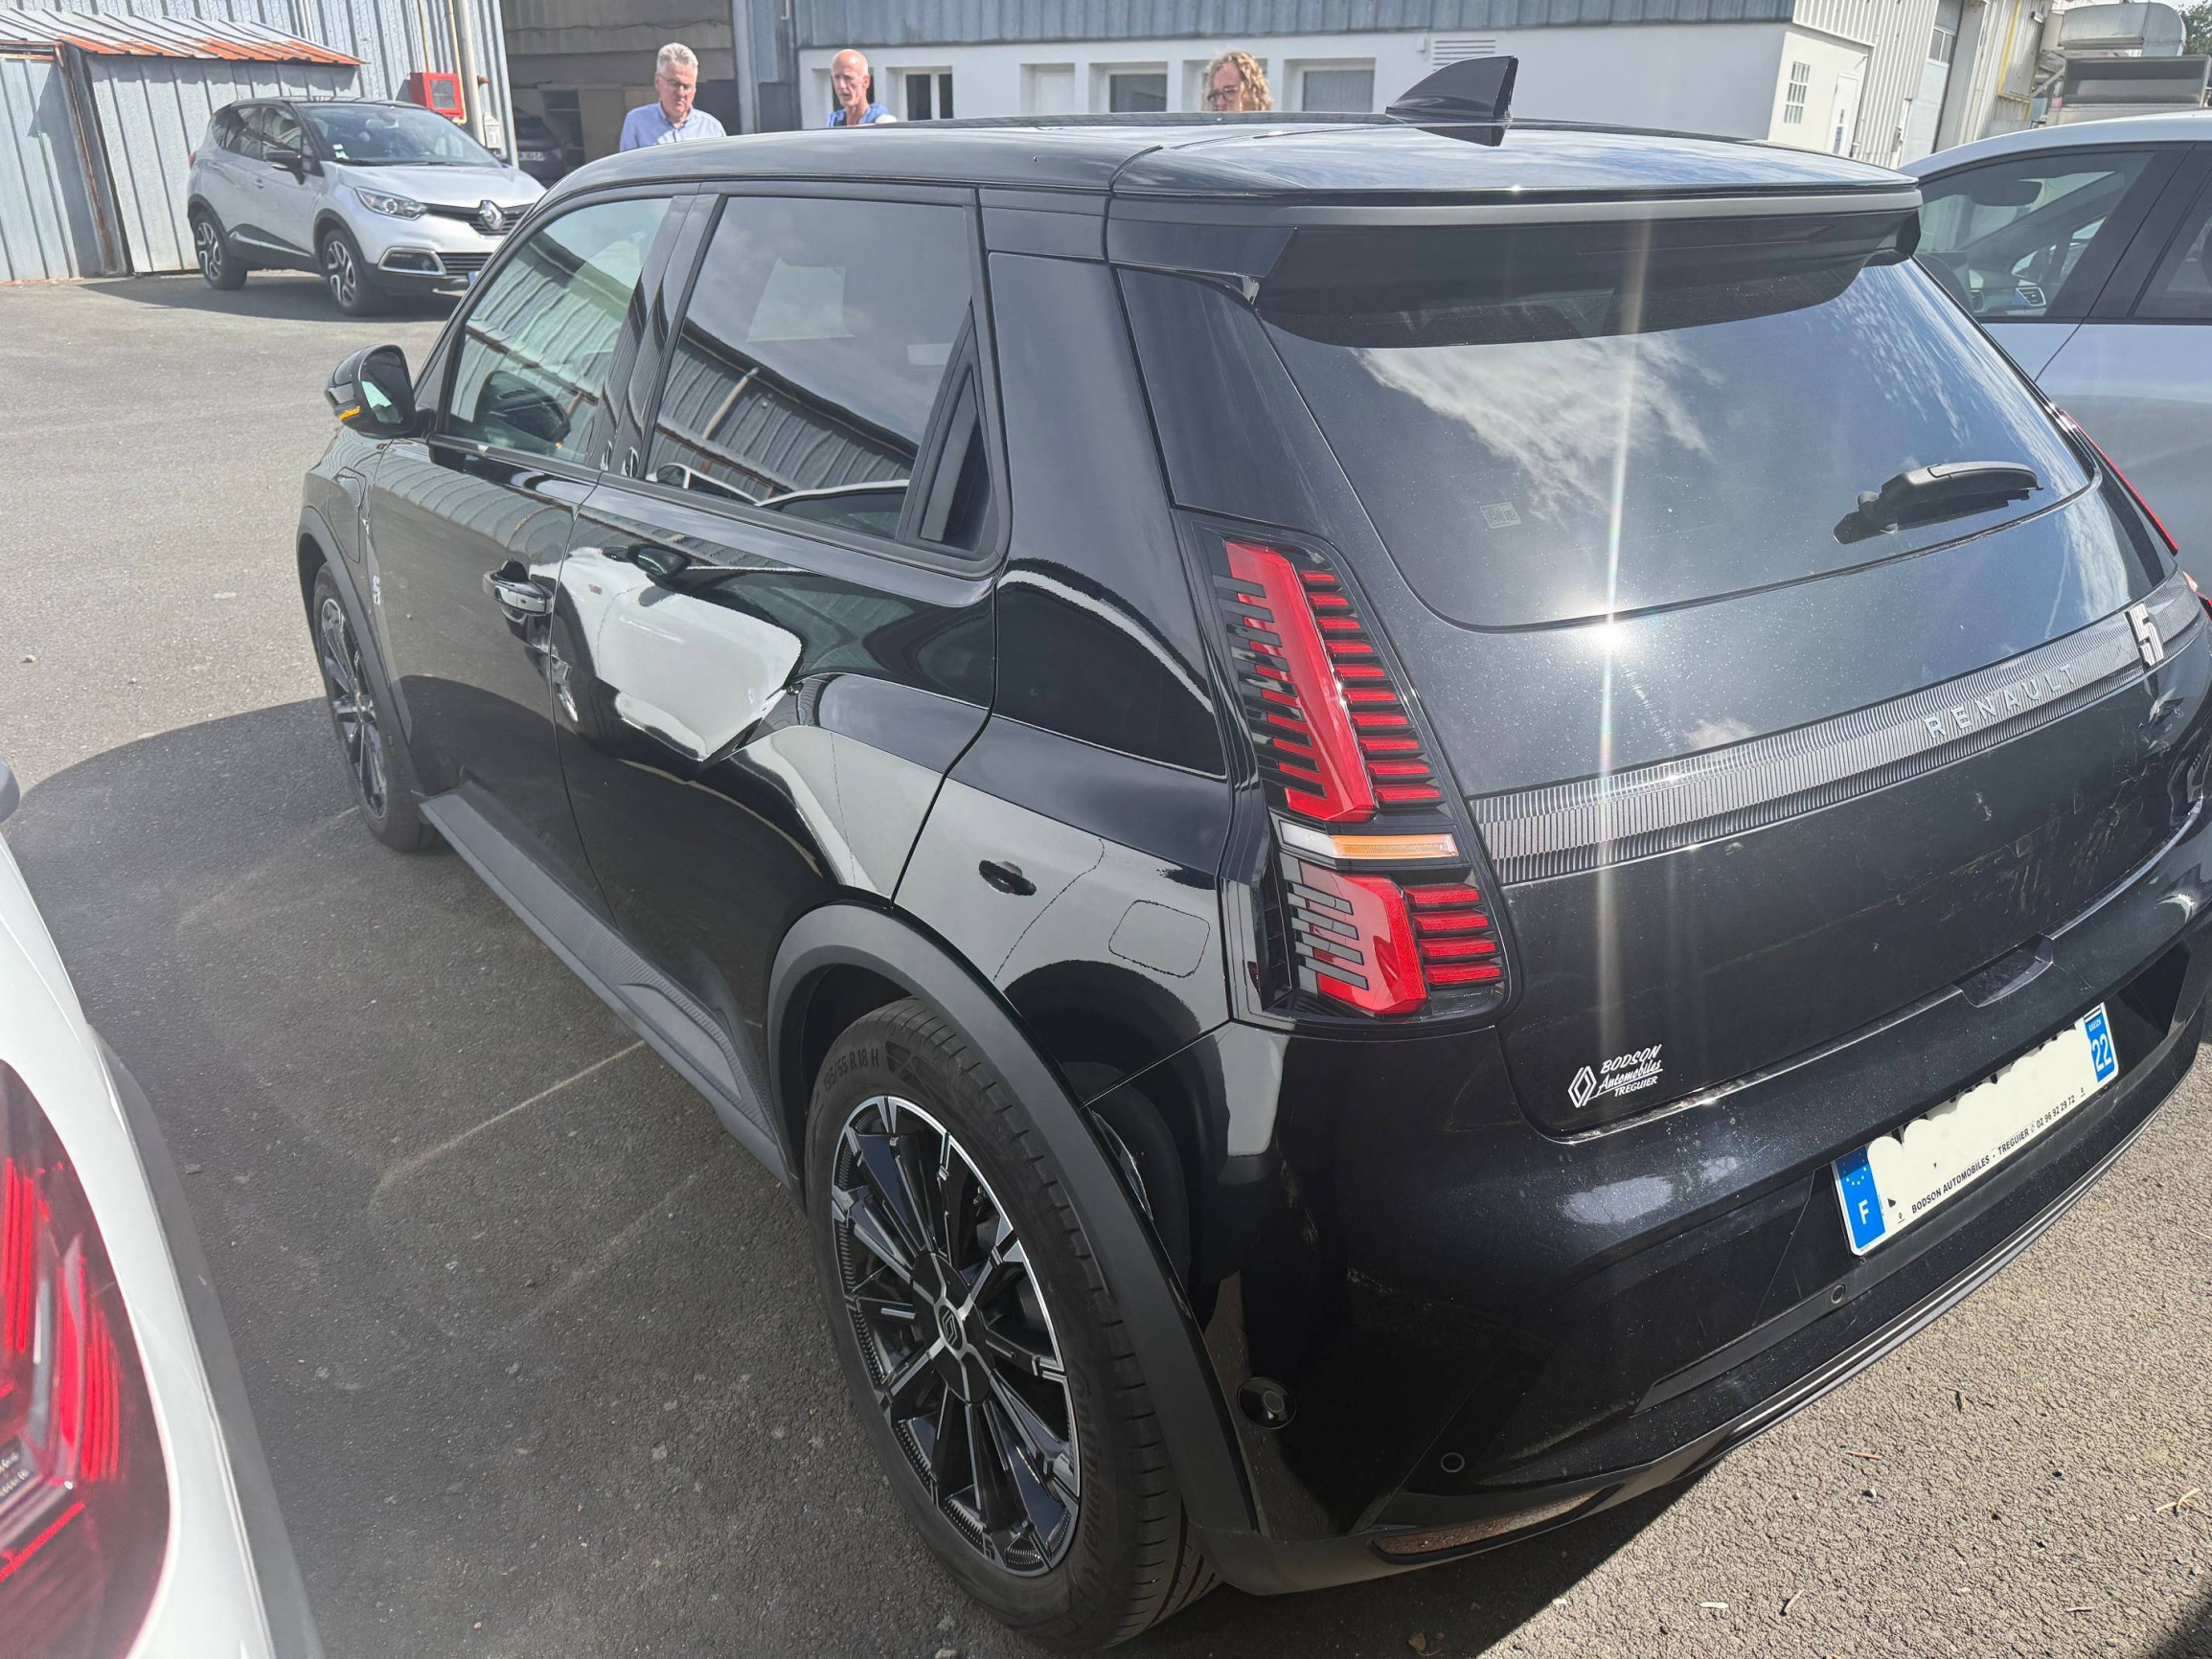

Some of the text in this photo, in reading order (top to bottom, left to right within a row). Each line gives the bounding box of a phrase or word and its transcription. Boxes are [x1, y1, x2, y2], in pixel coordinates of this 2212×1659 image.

[2122, 602, 2164, 670] 5
[1923, 663, 2077, 740] RENAULT
[824, 1048, 879, 1092] 195/55 R 18 H
[1600, 1043, 1663, 1074] BODSON
[2091, 1034, 2112, 1072] 22
[1599, 1059, 1662, 1091] Automobiles
[1614, 1076, 1658, 1097] TREGUIER
[1911, 1188, 1942, 1214] BODSON
[1943, 1154, 1990, 1193] AUTOMOBILES
[1997, 1128, 2030, 1155] TREGUIER
[2036, 1118, 2044, 1128] 02
[2044, 1111, 2052, 1124] 96
[2052, 1105, 2061, 1117] 92
[2060, 1101, 2068, 1111] 29
[2067, 1095, 2076, 1106] 72
[1859, 1198, 1869, 1225] F
